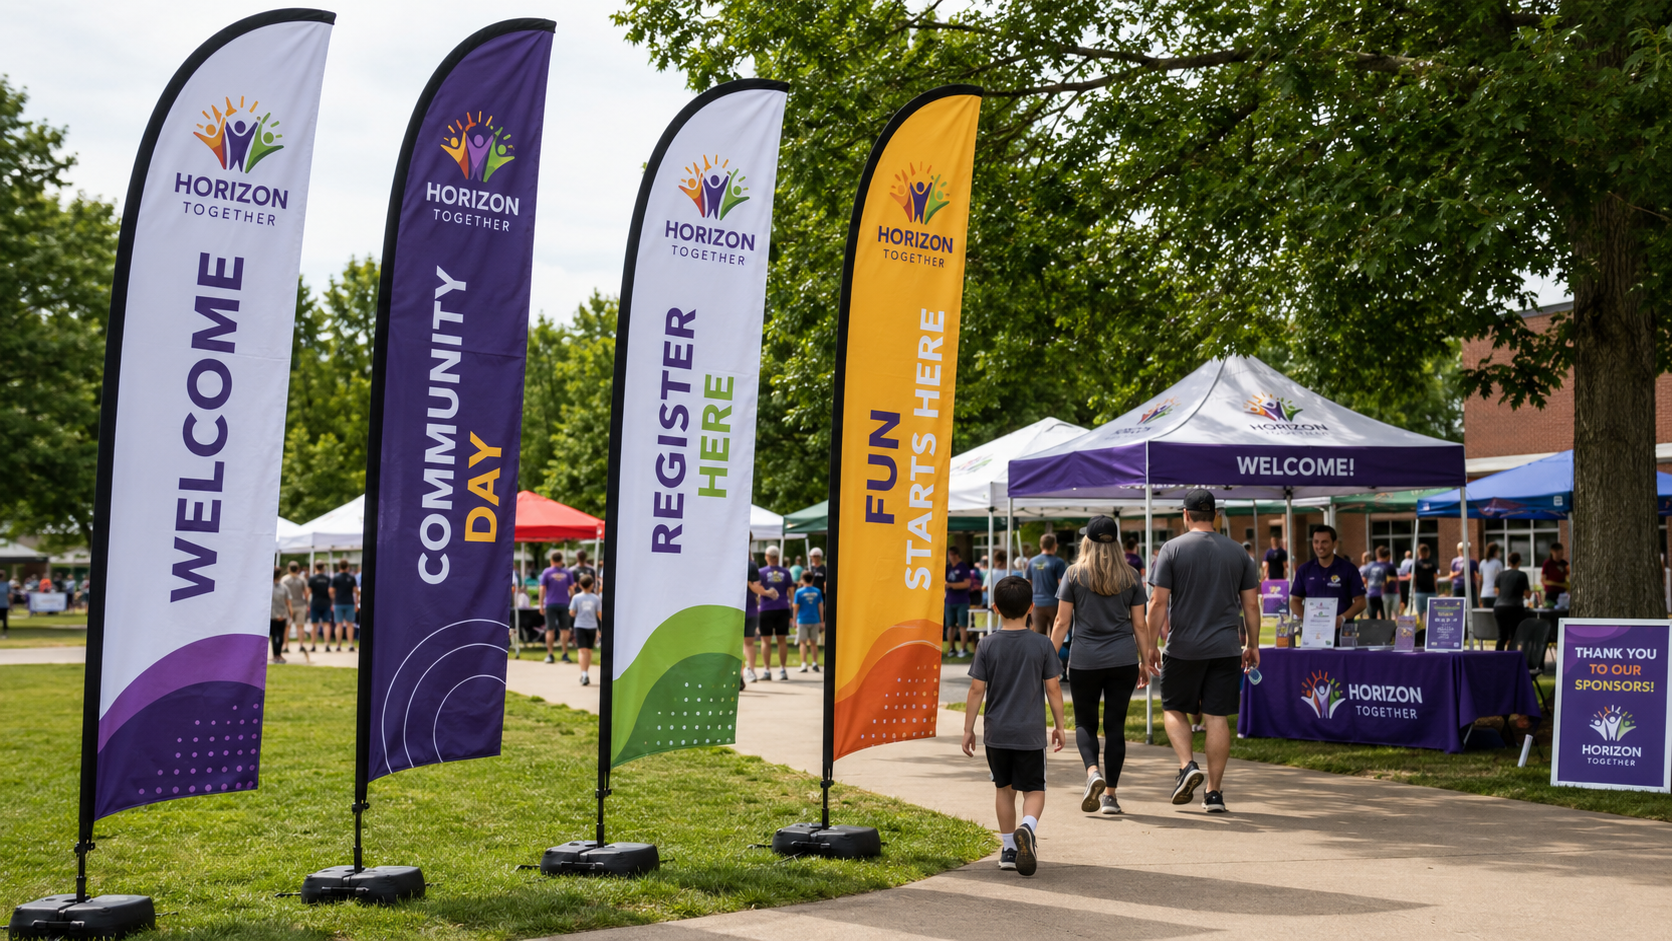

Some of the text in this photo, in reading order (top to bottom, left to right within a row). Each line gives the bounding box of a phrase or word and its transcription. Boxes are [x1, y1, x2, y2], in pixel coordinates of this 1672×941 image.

[174, 172, 289, 209] HORIZON
[426, 182, 520, 216] HORIZON
[183, 201, 276, 226] TOGETHER
[433, 208, 510, 232] TOGETHER
[665, 220, 755, 251] HORIZON
[878, 225, 953, 254] HORIZON
[672, 245, 745, 266] TOGETHER
[883, 248, 945, 268] TOGETHER
[170, 252, 245, 603] WELCOME
[417, 265, 467, 585] COMMUNITY
[651, 307, 697, 554] REGISTER
[697, 374, 735, 498] HERE
[1249, 423, 1329, 431] HORIZON
[904, 308, 945, 591] STARTS HERE
[865, 409, 901, 525] FUN
[1236, 456, 1355, 477] WELCOME!
[464, 431, 503, 543] DAY
[1575, 647, 1657, 660] THANK YOU
[1589, 663, 1642, 676] TO OUR
[1348, 683, 1423, 704] HORIZON
[1575, 679, 1655, 693] SPONSORS!
[1355, 705, 1418, 720] TOGETHER
[1582, 744, 1642, 758] HORIZON
[1587, 757, 1636, 767] TOGETHER
